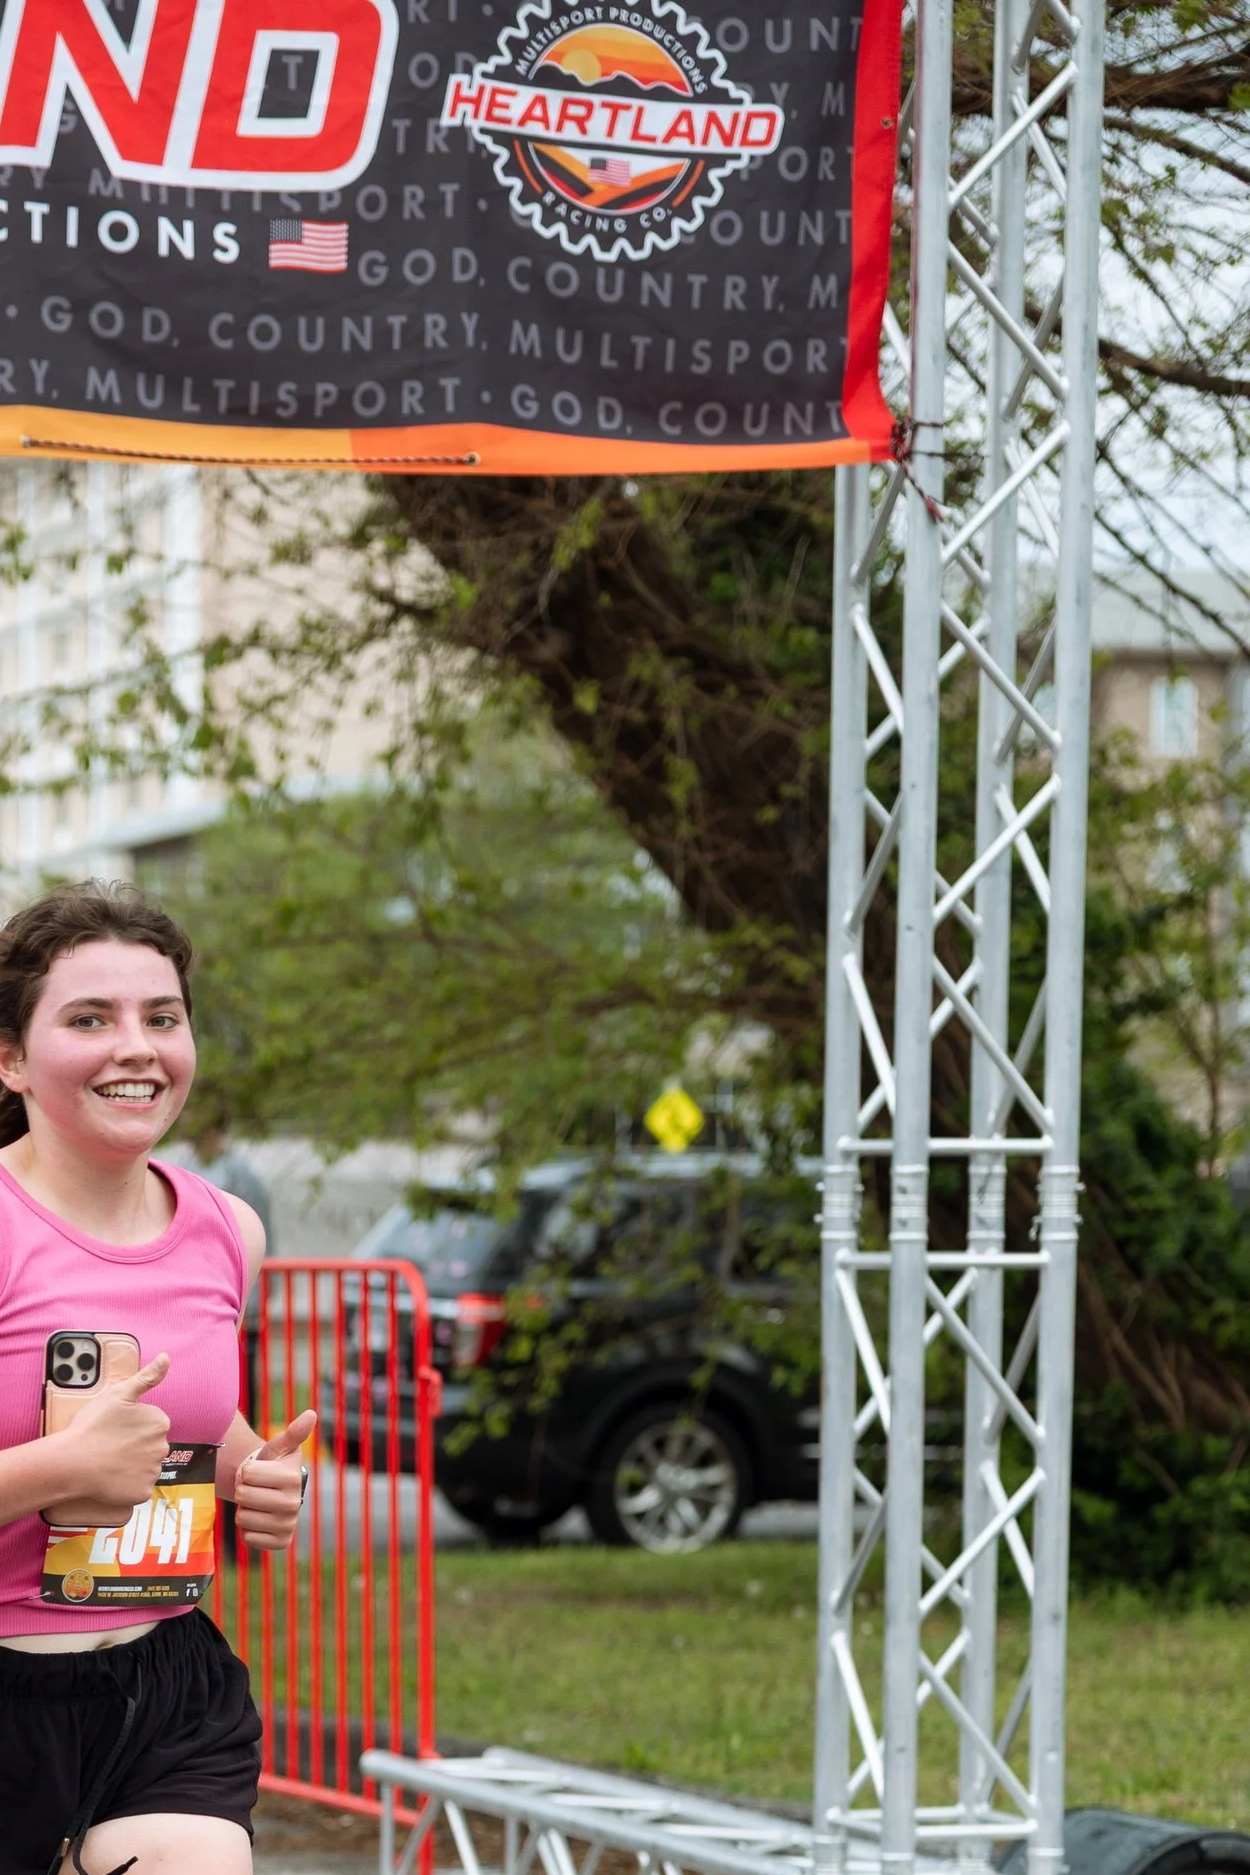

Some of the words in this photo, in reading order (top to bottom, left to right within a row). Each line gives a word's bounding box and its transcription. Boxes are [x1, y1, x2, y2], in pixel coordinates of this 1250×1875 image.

[515, 6, 603, 76] MULTISPORT
[609, 6, 708, 94] PRODUCTIONS
[447, 80, 778, 149] HEARTLAND
[543, 190, 628, 234] RACING
[357, 247, 486, 288] GOD,
[506, 256, 786, 313] COUNTRY,
[40, 295, 181, 349] GOD,
[208, 311, 488, 353] COUNTRY,
[508, 319, 849, 375] MULTISPOR
[85, 365, 462, 419] MULTISPORT
[510, 383, 633, 436] GOD,
[88, 1497, 194, 1565] 2041
